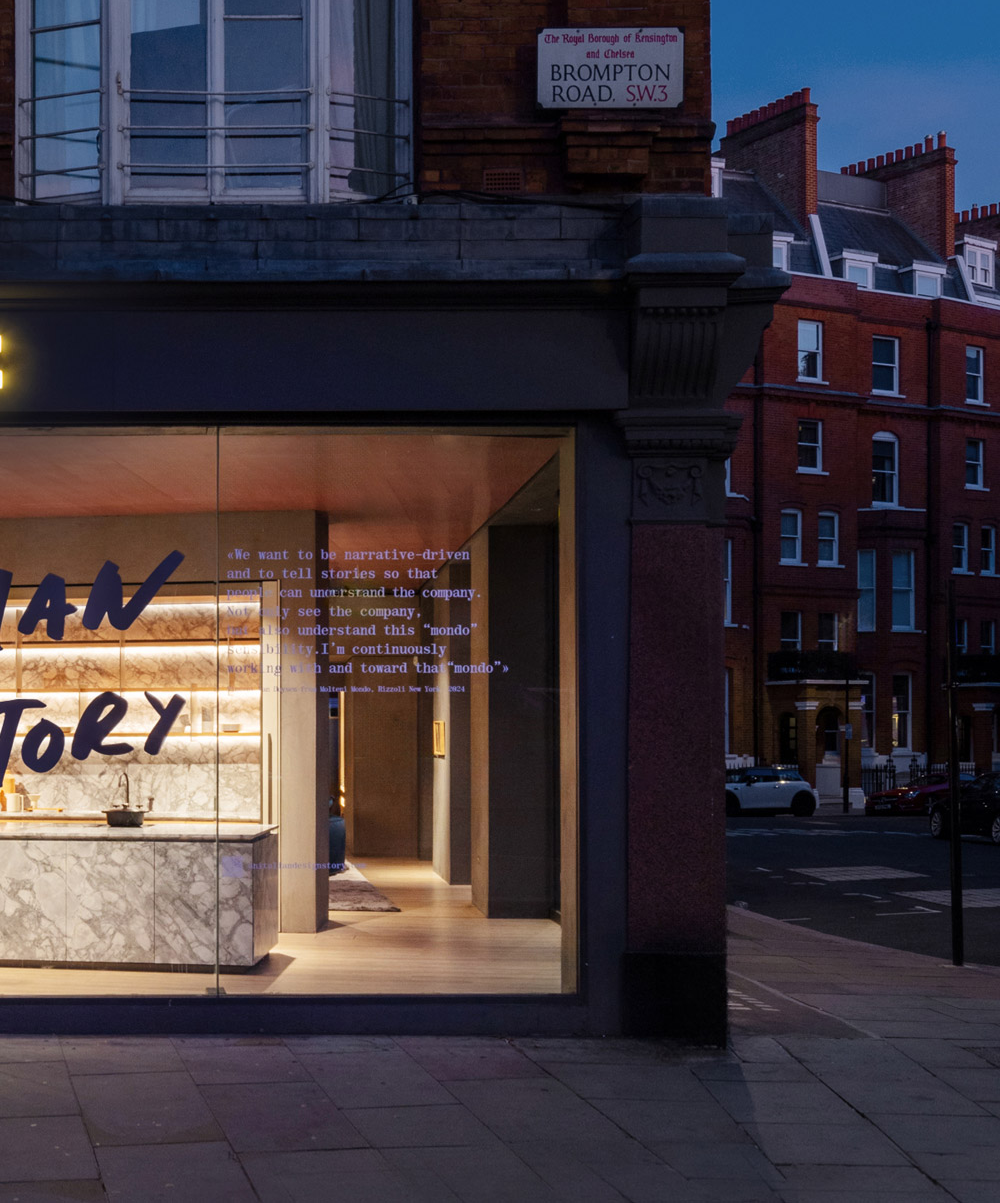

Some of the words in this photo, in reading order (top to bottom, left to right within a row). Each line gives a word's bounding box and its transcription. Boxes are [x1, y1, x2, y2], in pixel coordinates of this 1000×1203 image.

[544, 34, 560, 44] The
[562, 33, 585, 46] Royal
[588, 33, 620, 46] Borough
[623, 33, 631, 43] of
[635, 33, 678, 45] Kensington
[586, 49, 600, 59] and
[604, 49, 635, 59] Chelsea
[550, 64, 671, 82] BROMPTON
[258, 549, 290, 561] want
[298, 549, 314, 561] to
[320, 548, 337, 561] be
[344, 548, 470, 561] narrative-driven
[227, 567, 251, 579] and
[258, 568, 274, 579] to
[282, 567, 313, 579] tell
[321, 567, 376, 579] stories
[384, 571, 400, 579] so
[407, 567, 439, 579] that
[226, 586, 272, 601] people
[280, 589, 303, 598] can
[310, 586, 386, 598] understand
[393, 586, 416, 598] the
[422, 589, 481, 601] company.
[226, 606, 249, 617] Not
[298, 608, 321, 617] see
[329, 606, 353, 617] the
[360, 607, 421, 619] company,
[298, 624, 376, 636] understand
[384, 624, 416, 636] this
[352, 643, 447, 658] continuously
[227, 662, 282, 676] working
[290, 662, 322, 674] with
[329, 662, 353, 674] and
[361, 662, 408, 674] toward
